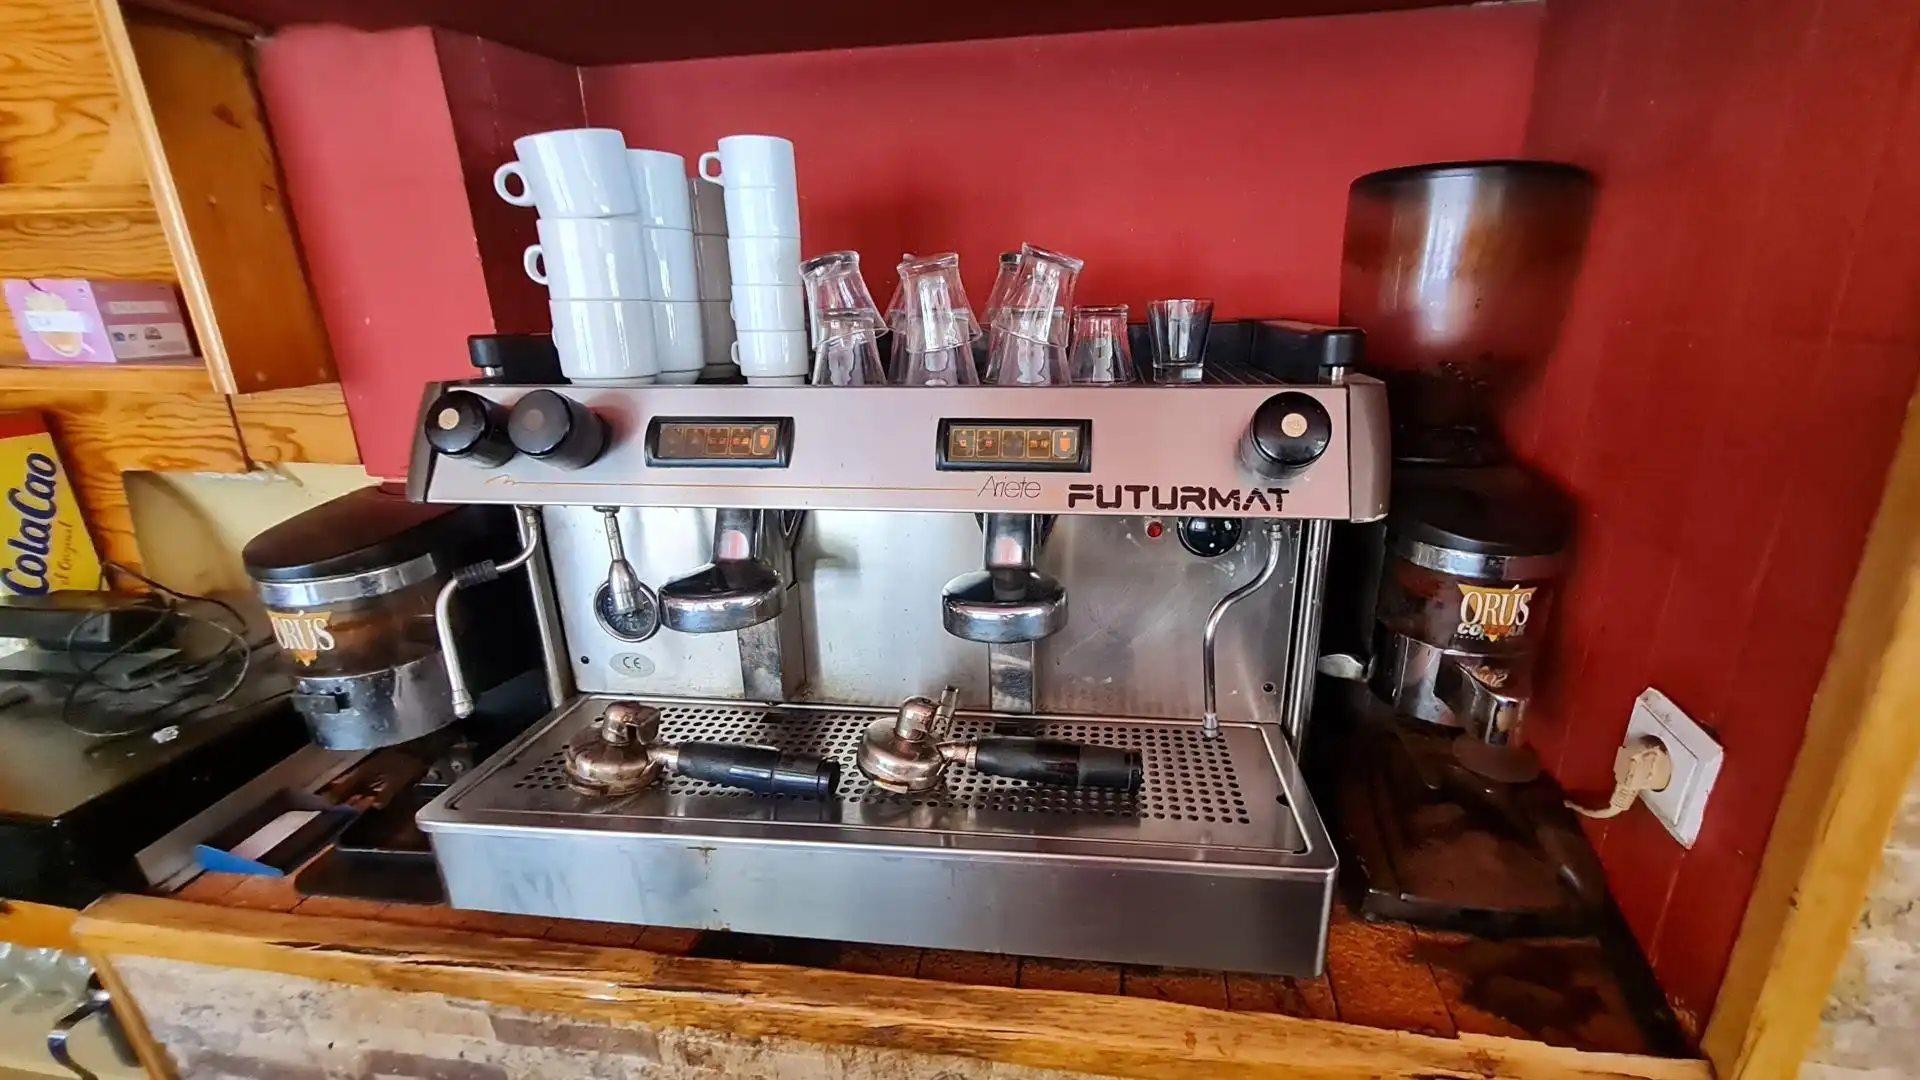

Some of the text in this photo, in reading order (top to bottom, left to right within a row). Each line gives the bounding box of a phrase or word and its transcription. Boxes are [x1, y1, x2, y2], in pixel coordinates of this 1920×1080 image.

[978, 475, 1041, 499] Ariete
[1068, 484, 1290, 512] FUTURMAT
[0, 452, 57, 596] ColaCao
[1460, 584, 1532, 626] ORÚS
[622, 656, 641, 670] CE
